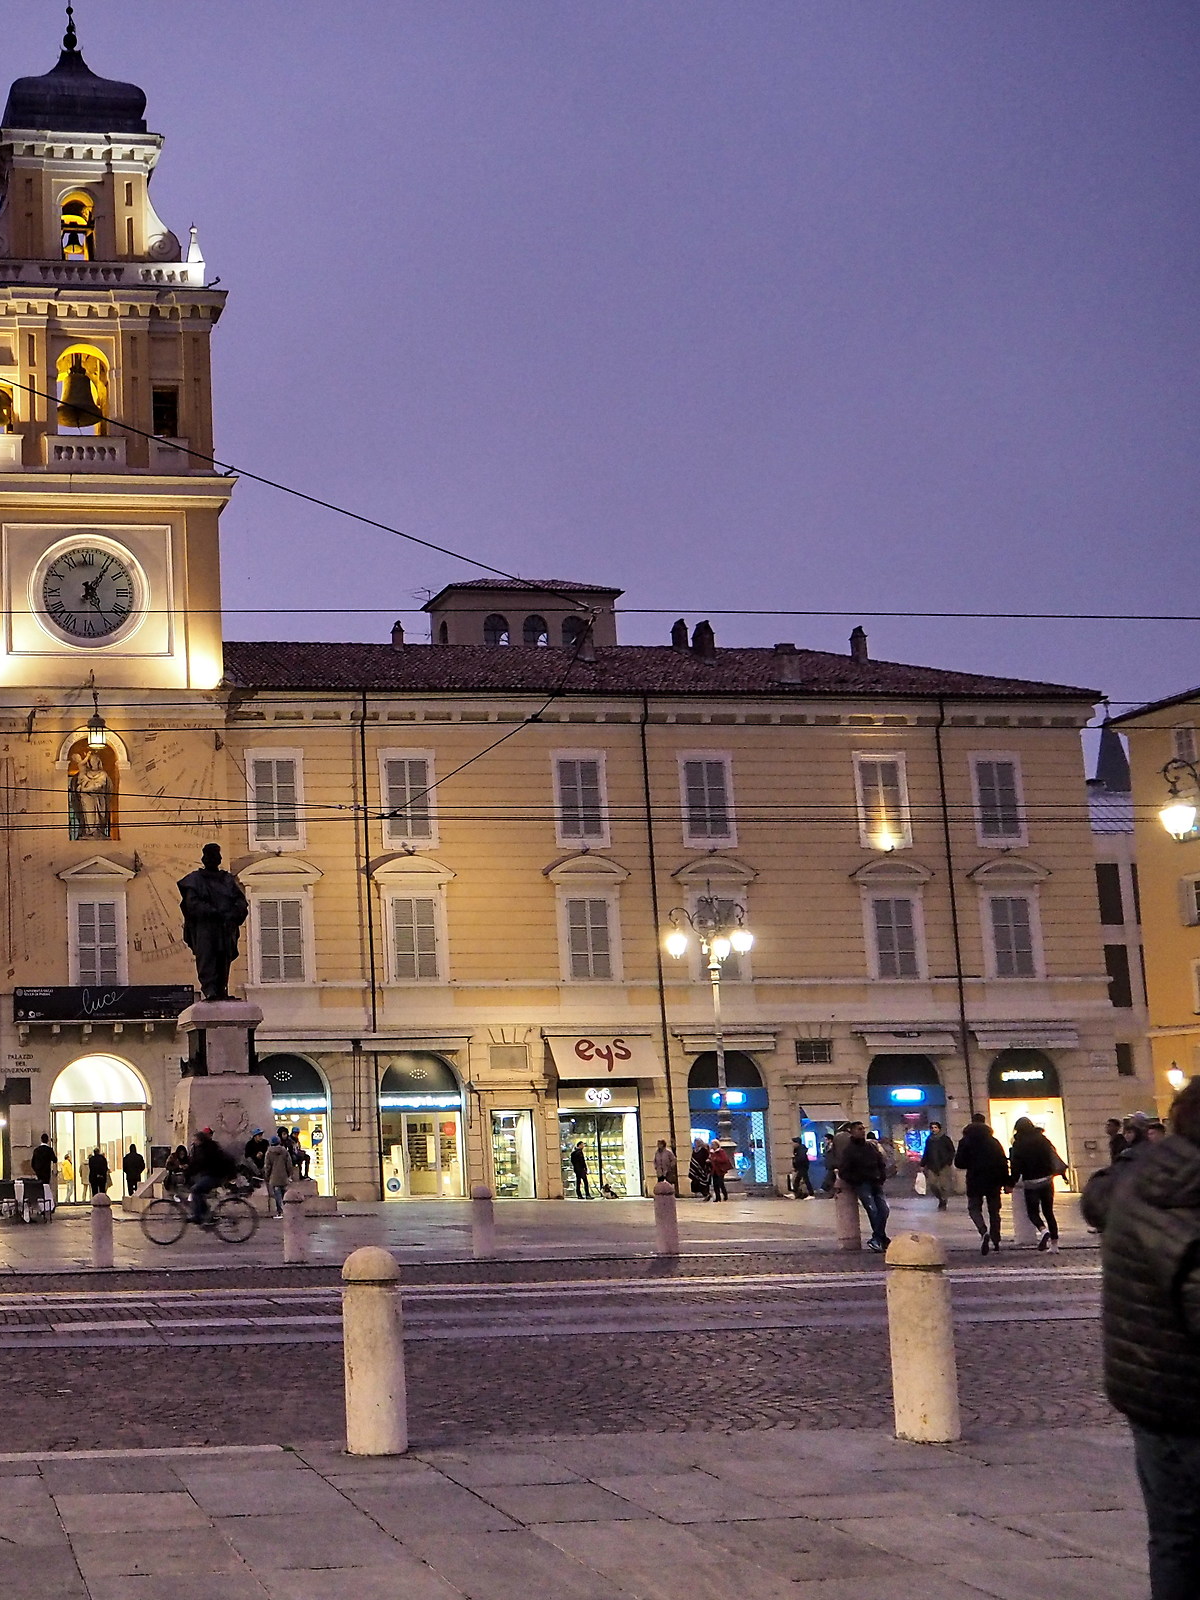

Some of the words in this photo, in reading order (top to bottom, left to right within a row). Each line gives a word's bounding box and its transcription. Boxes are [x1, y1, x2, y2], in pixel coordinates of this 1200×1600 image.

[115, 588, 129, 598] III
[77, 988, 128, 1016] luce
[574, 1038, 632, 1073] eys
[585, 1087, 612, 1107] eys
